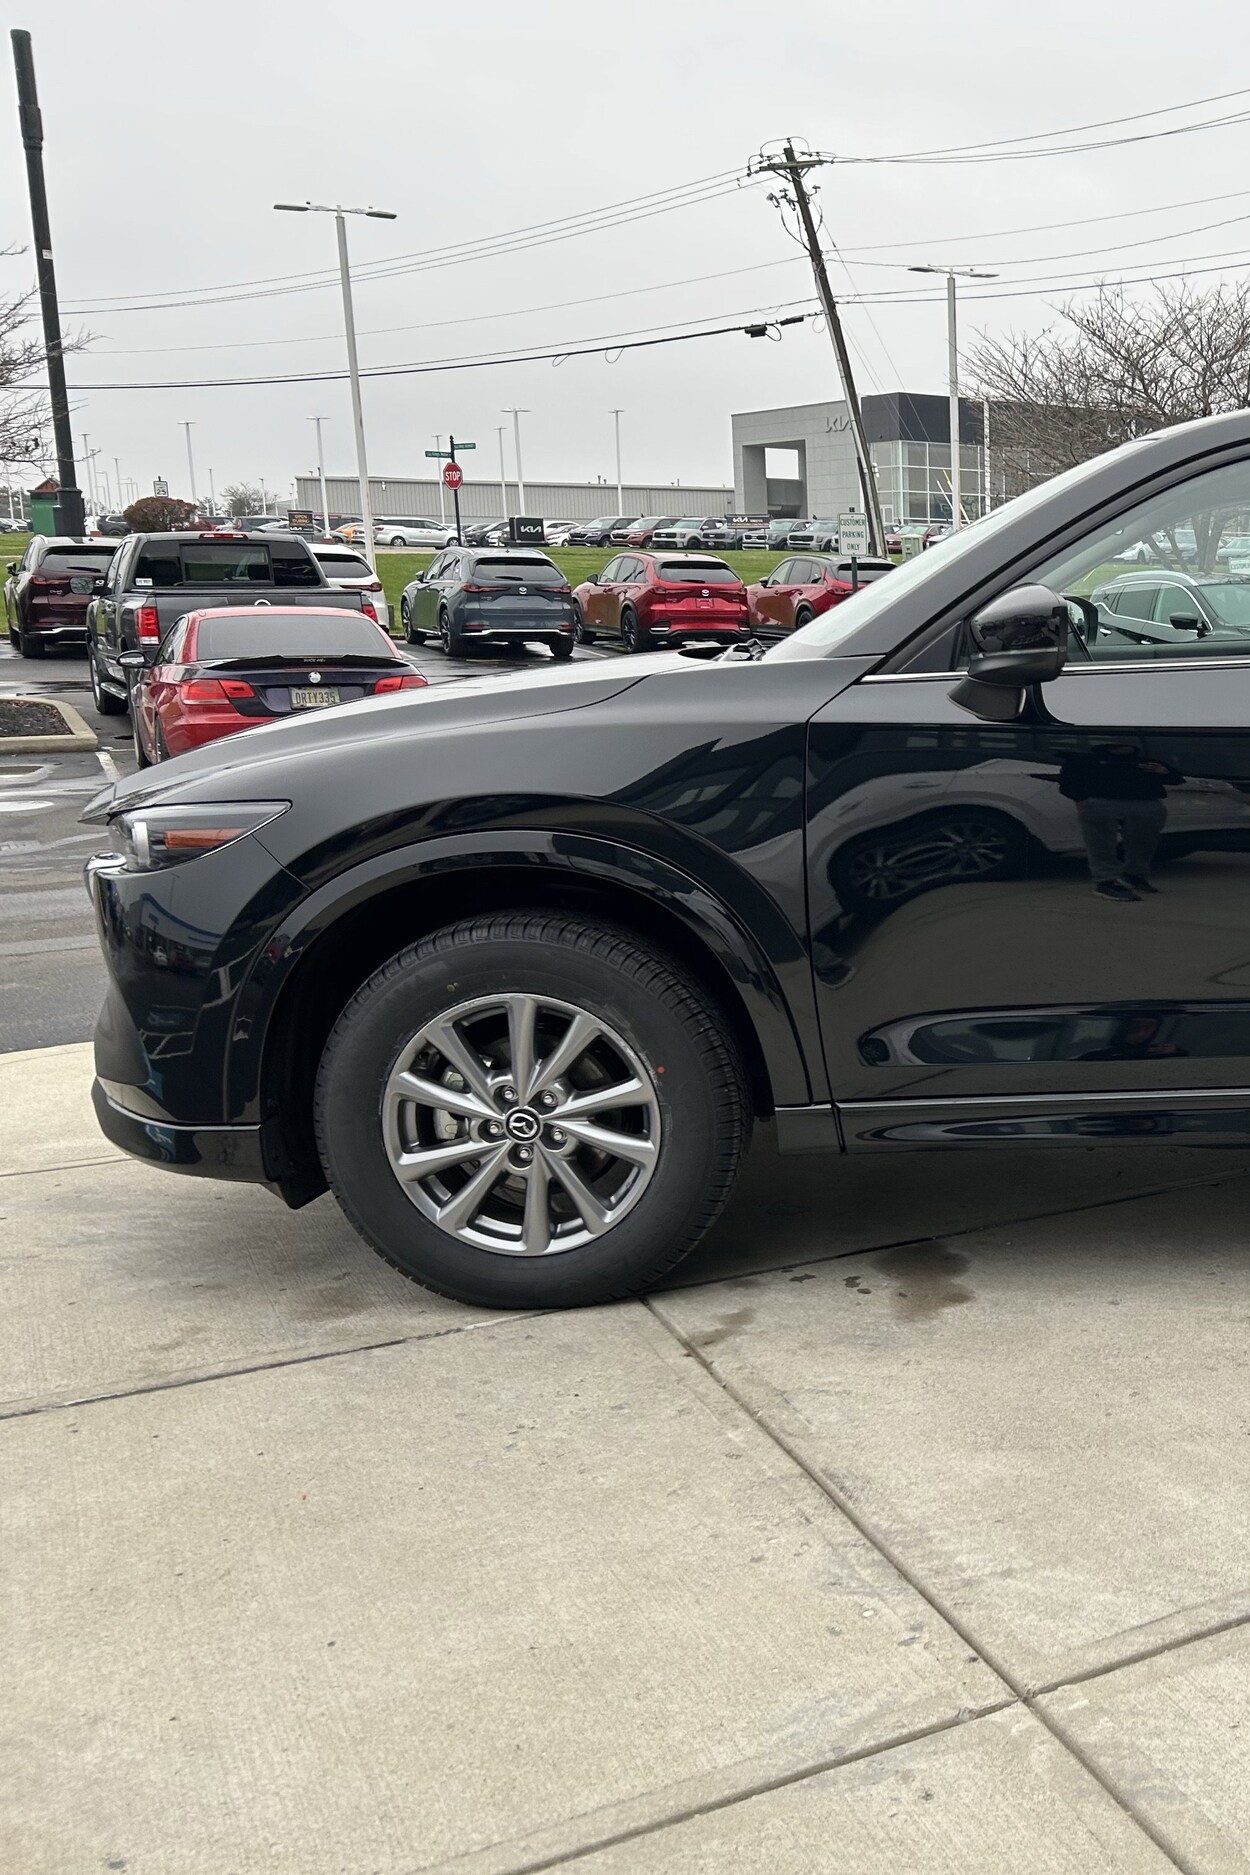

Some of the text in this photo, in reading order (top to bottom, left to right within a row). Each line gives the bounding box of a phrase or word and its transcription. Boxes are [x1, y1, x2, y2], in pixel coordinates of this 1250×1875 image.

[445, 471, 461, 481] STOP
[520, 525, 542, 533] KIA
[295, 691, 336, 704] DRTY335
